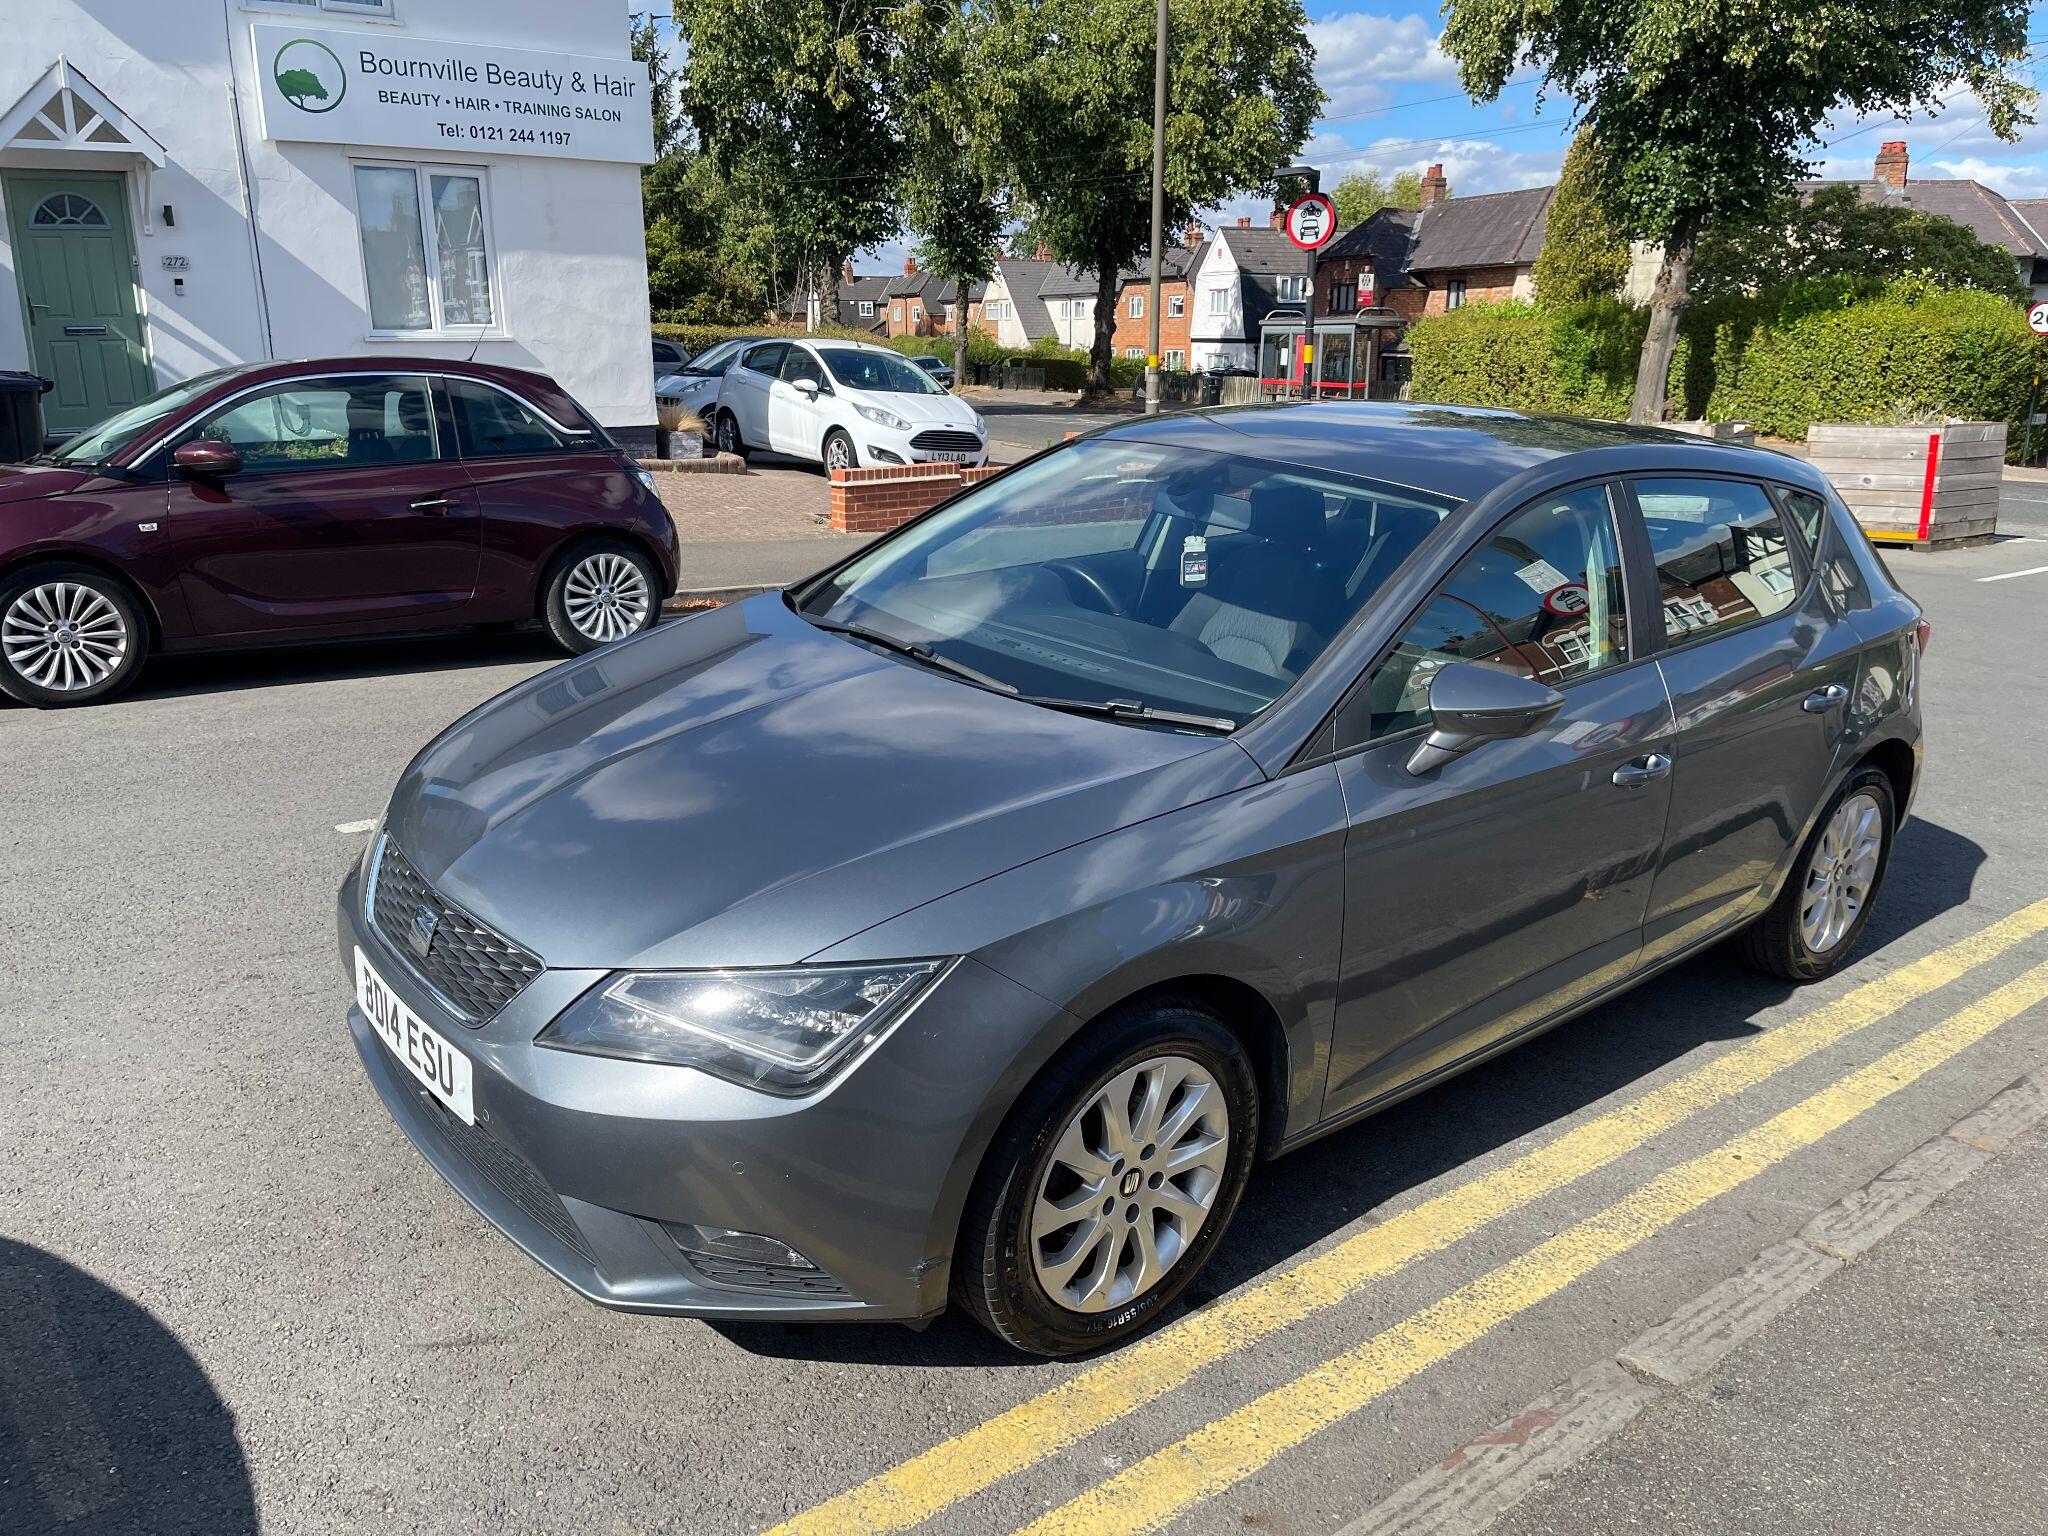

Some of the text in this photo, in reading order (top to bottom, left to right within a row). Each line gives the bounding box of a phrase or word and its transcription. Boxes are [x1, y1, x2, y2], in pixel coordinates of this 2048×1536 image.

[360, 51, 636, 97] Bournville Beauty & Hair
[378, 90, 621, 122] BEAUTY HAIR TRAINING SALON
[437, 122, 571, 146] Tel: 0121 244 1197
[166, 256, 186, 266] 272
[2032, 311, 2048, 325] 2
[406, 1015, 455, 1097] ESU
